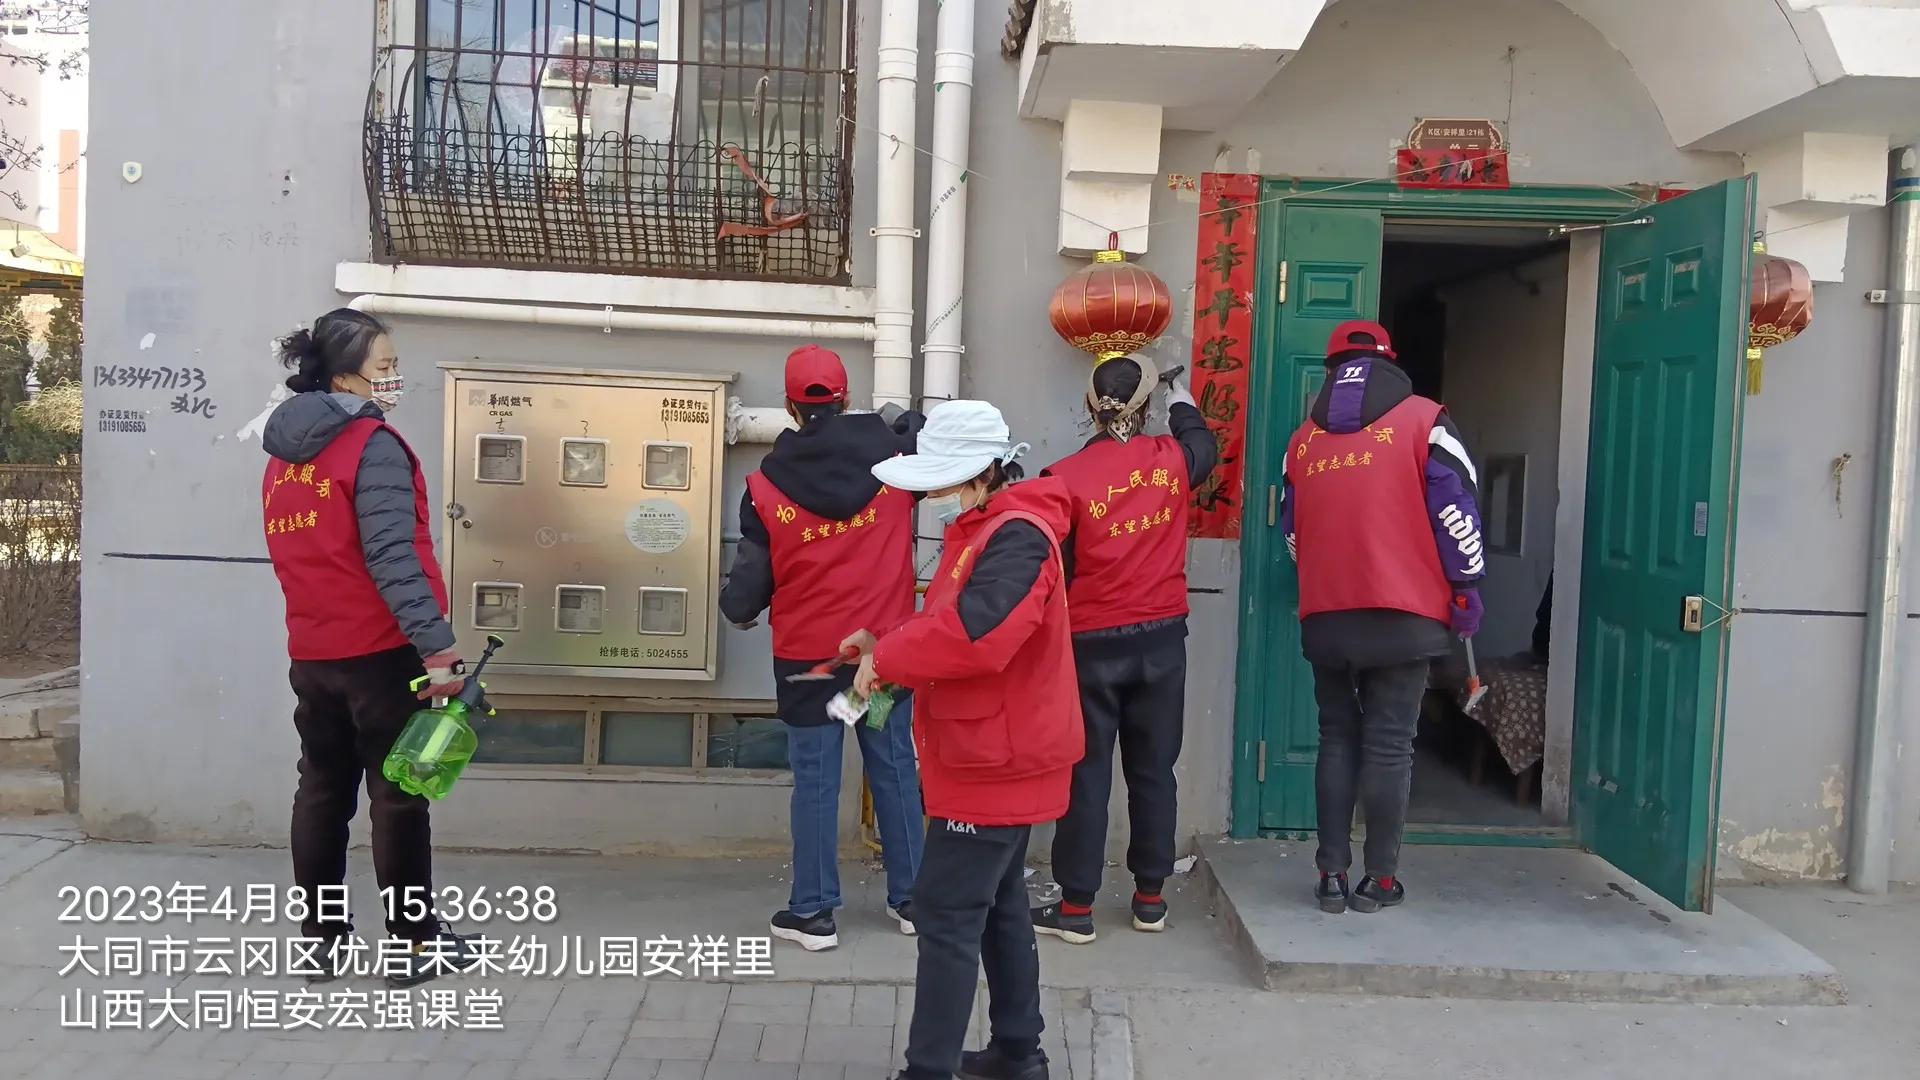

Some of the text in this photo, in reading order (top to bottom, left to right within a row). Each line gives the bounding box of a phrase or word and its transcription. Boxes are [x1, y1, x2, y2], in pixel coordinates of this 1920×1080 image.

[93, 365, 207, 392] 13633477133
[99, 421, 146, 432] 13191085653
[661, 409, 710, 423] 13191085653
[1306, 451, 1373, 477] 东望志愿者
[267, 509, 318, 535] 东望志愿者
[801, 508, 877, 543] 东望志愿者
[1109, 507, 1172, 537] 东望志愿者
[946, 819, 977, 834] K&K
